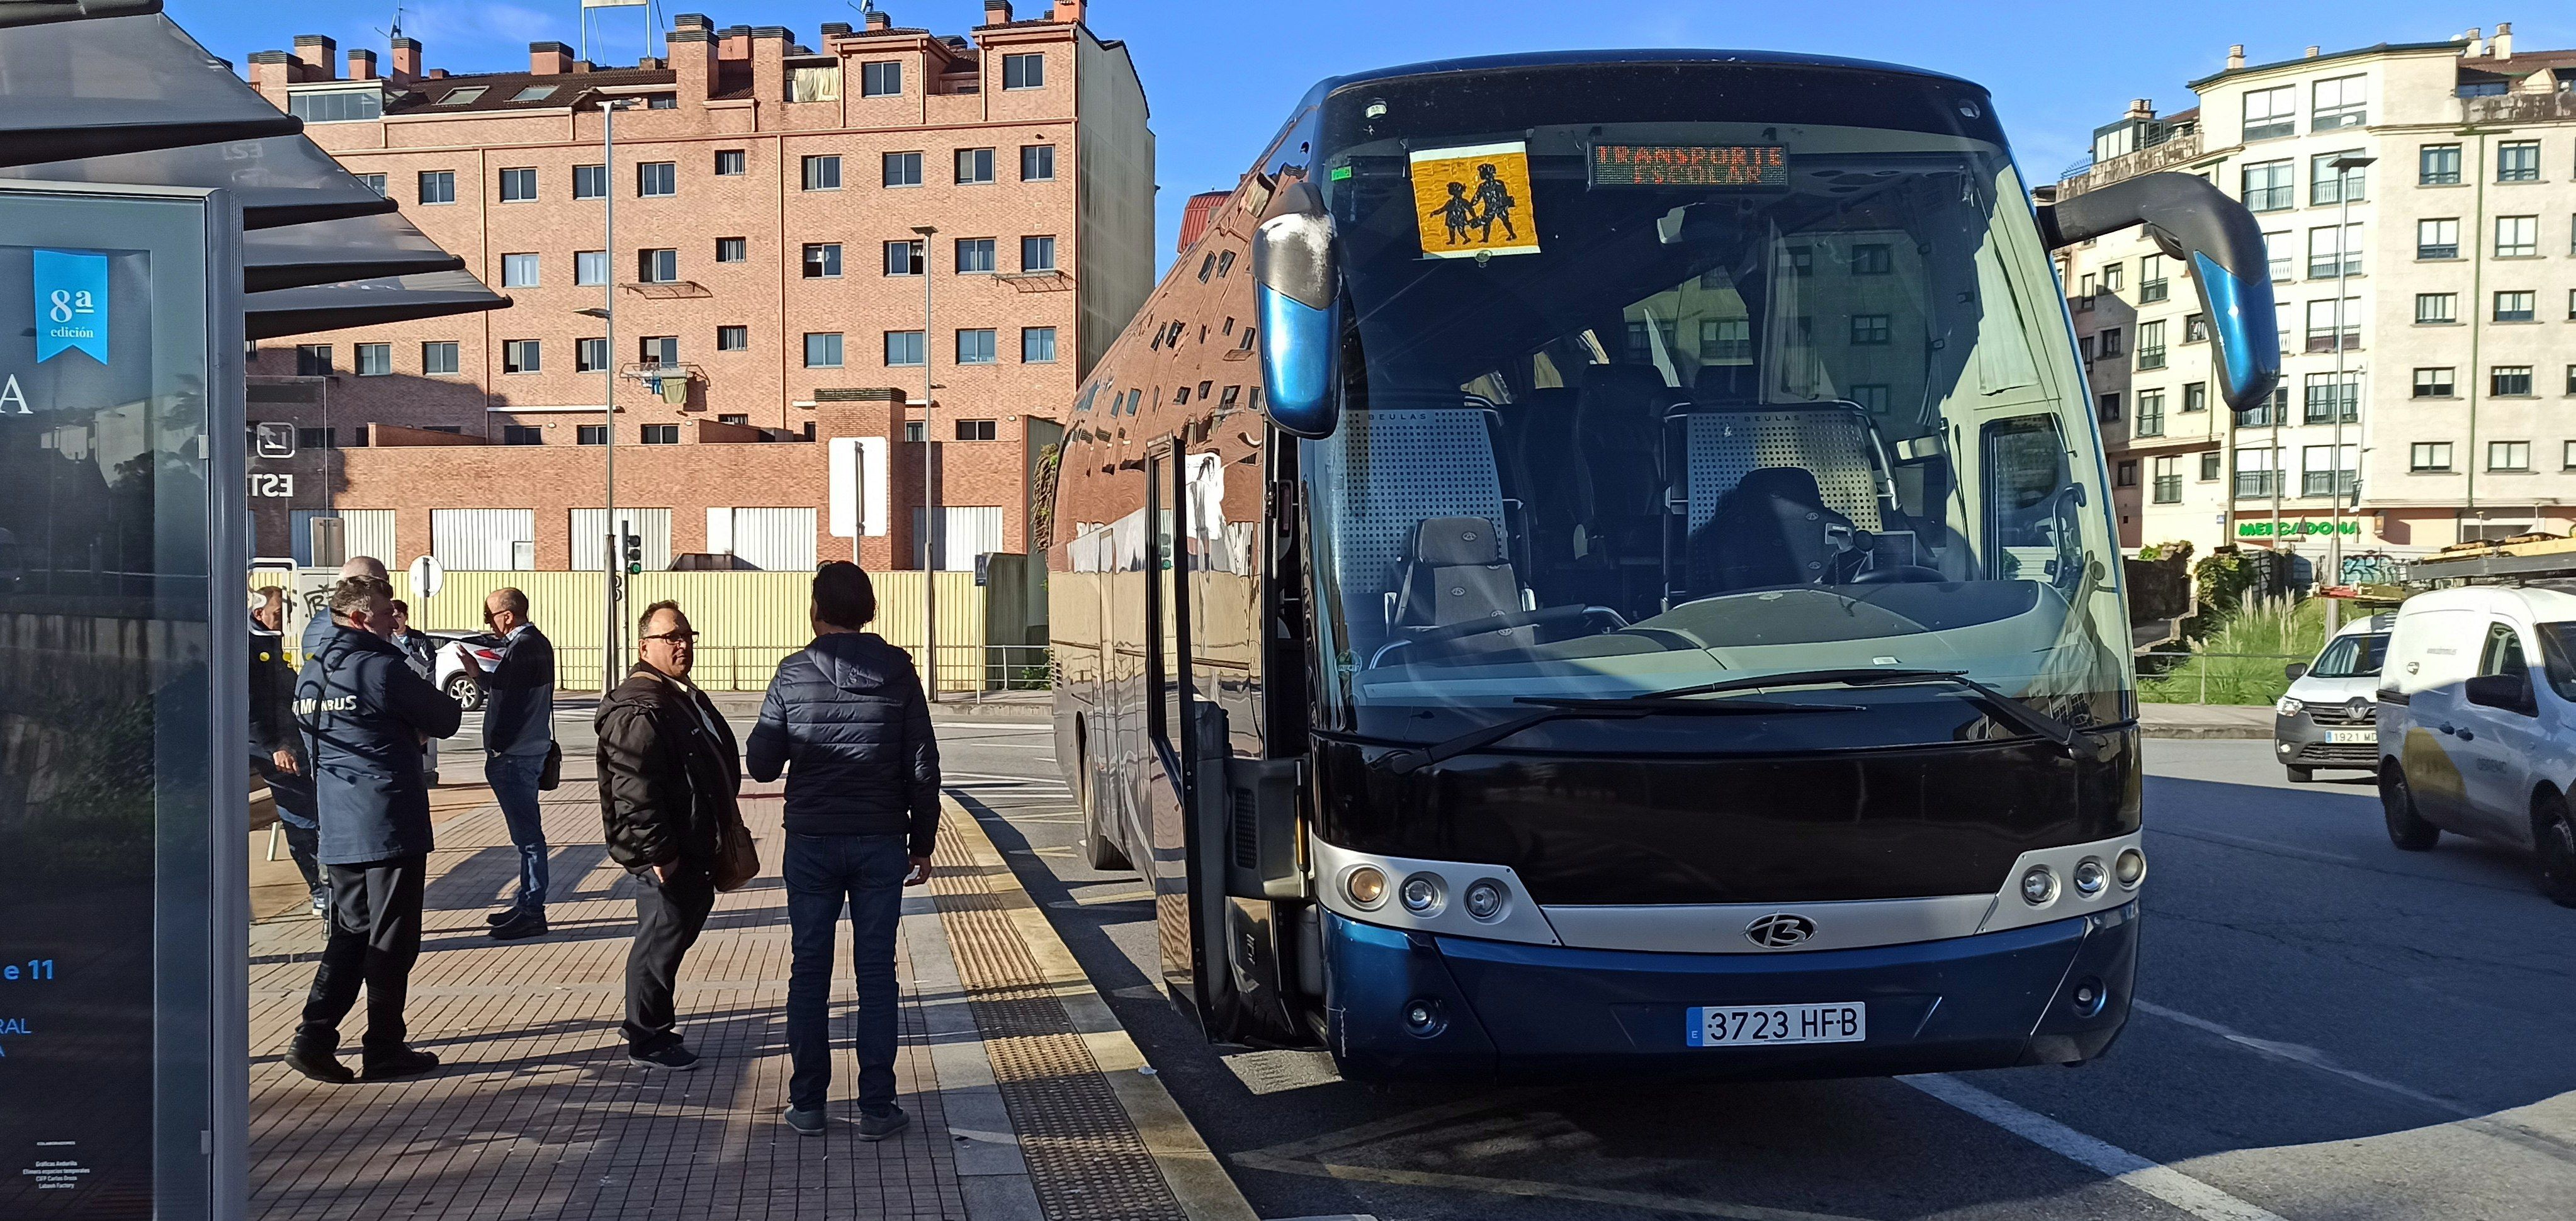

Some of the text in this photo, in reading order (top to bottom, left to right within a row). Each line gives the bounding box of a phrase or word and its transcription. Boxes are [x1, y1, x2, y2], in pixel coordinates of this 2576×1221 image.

[1596, 145, 1783, 166] TRANSPORTE
[1634, 165, 1761, 184] ESCOLAR
[50, 326, 94, 338] edición
[2334, 733, 2359, 742] 1921
[28, 959, 53, 979] 11
[1709, 1011, 1789, 1040] 3723
[1801, 1008, 1858, 1038] HFB
